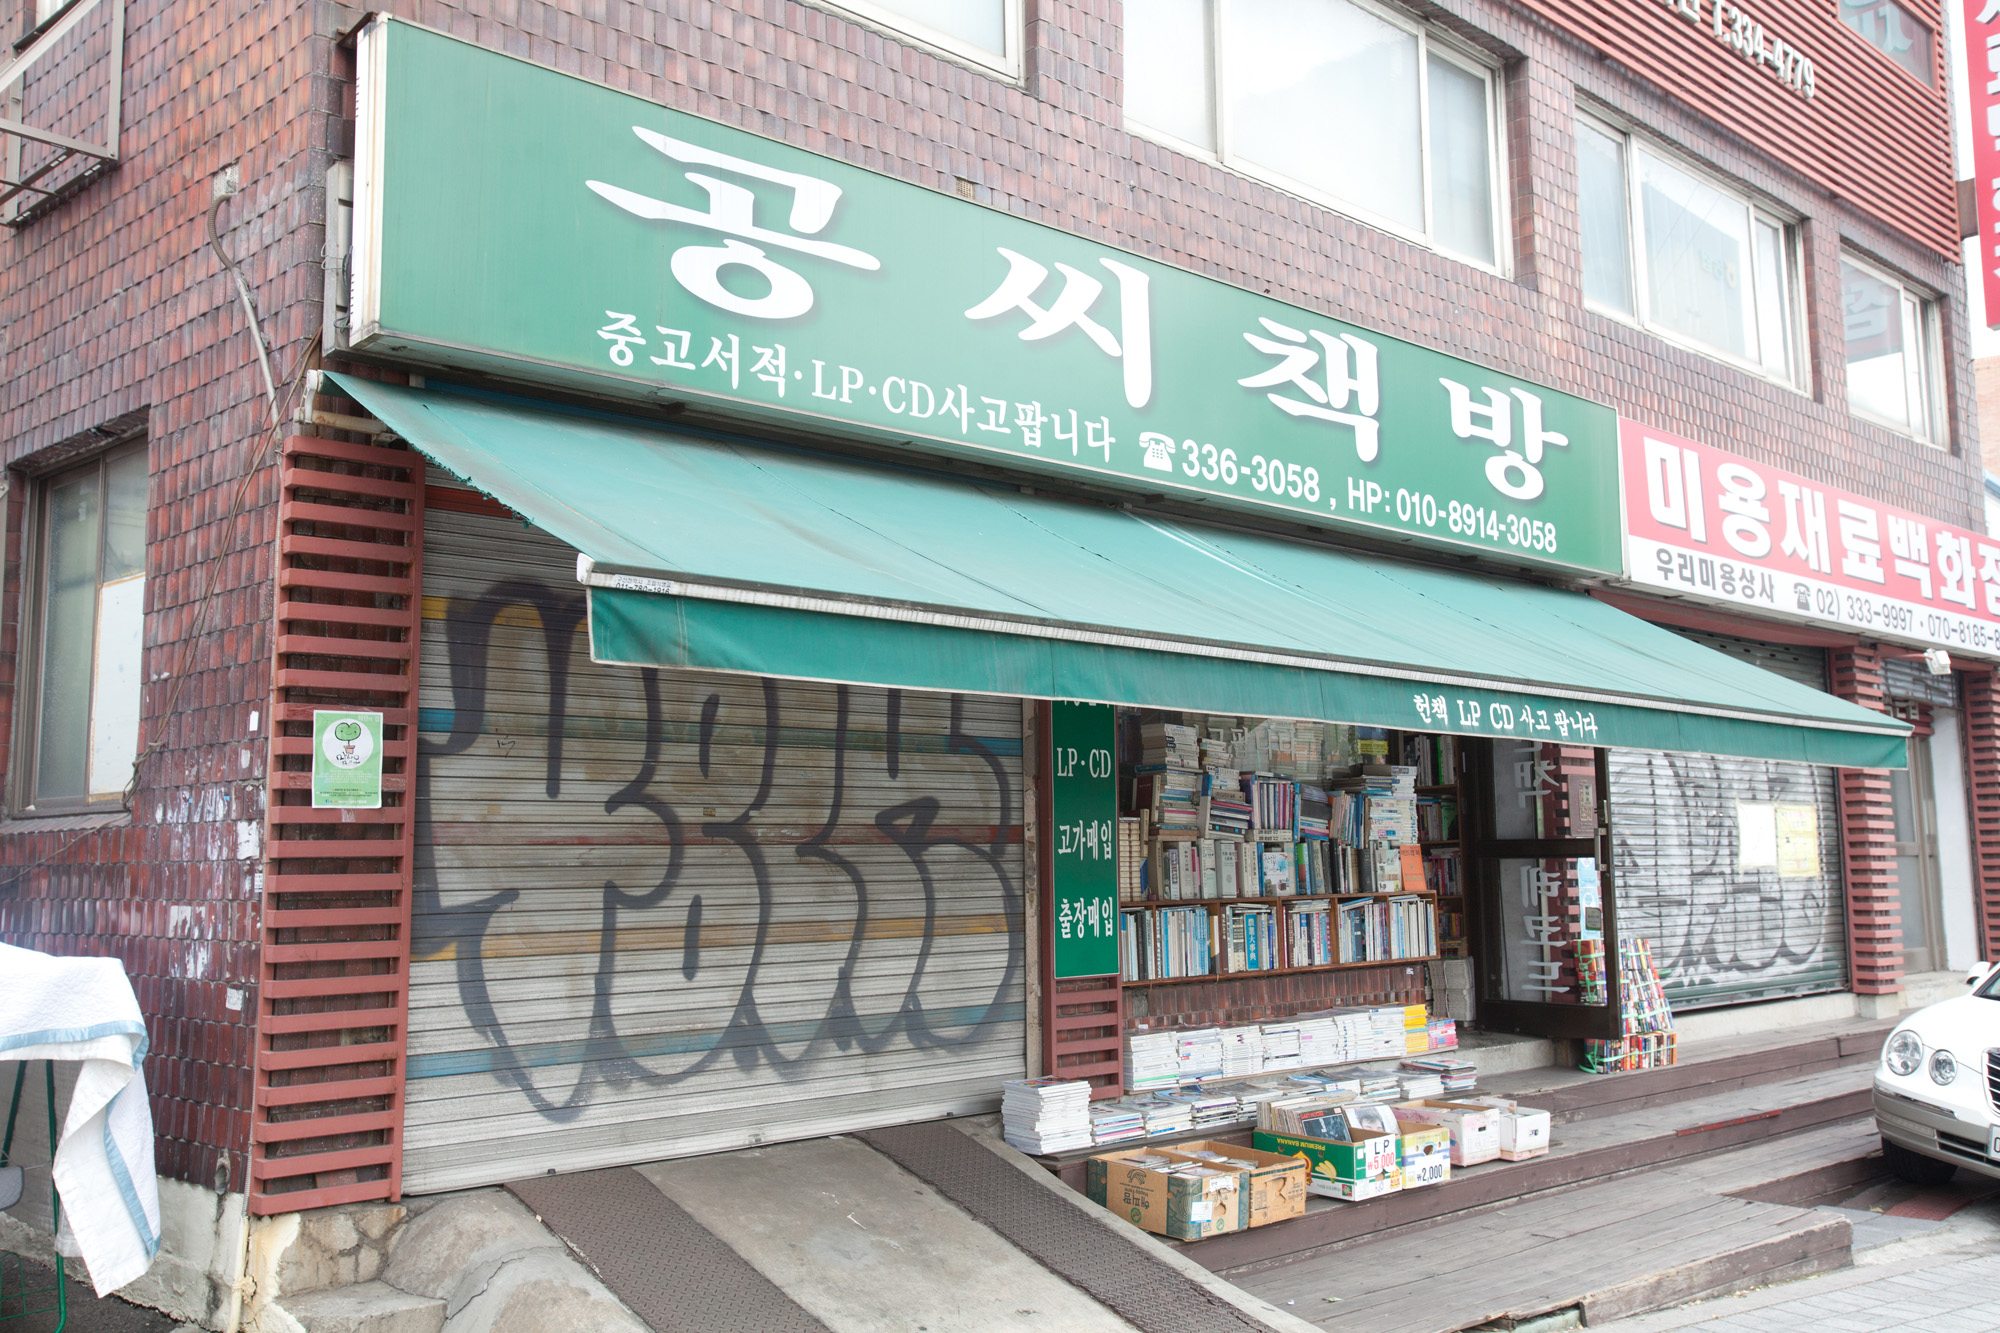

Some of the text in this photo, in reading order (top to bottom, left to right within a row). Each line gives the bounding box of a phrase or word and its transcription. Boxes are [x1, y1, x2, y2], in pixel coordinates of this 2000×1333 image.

[1656, 548, 1774, 603] 우리미용상사
[1413, 693, 1448, 726] 헌책
[1456, 699, 1481, 726] LP
[1489, 702, 1515, 730] CD
[1057, 819, 1113, 861] 고가매입
[1058, 896, 1114, 939] 출장매입
[1276, 1137, 1326, 1151] PREMIUM BANANA
